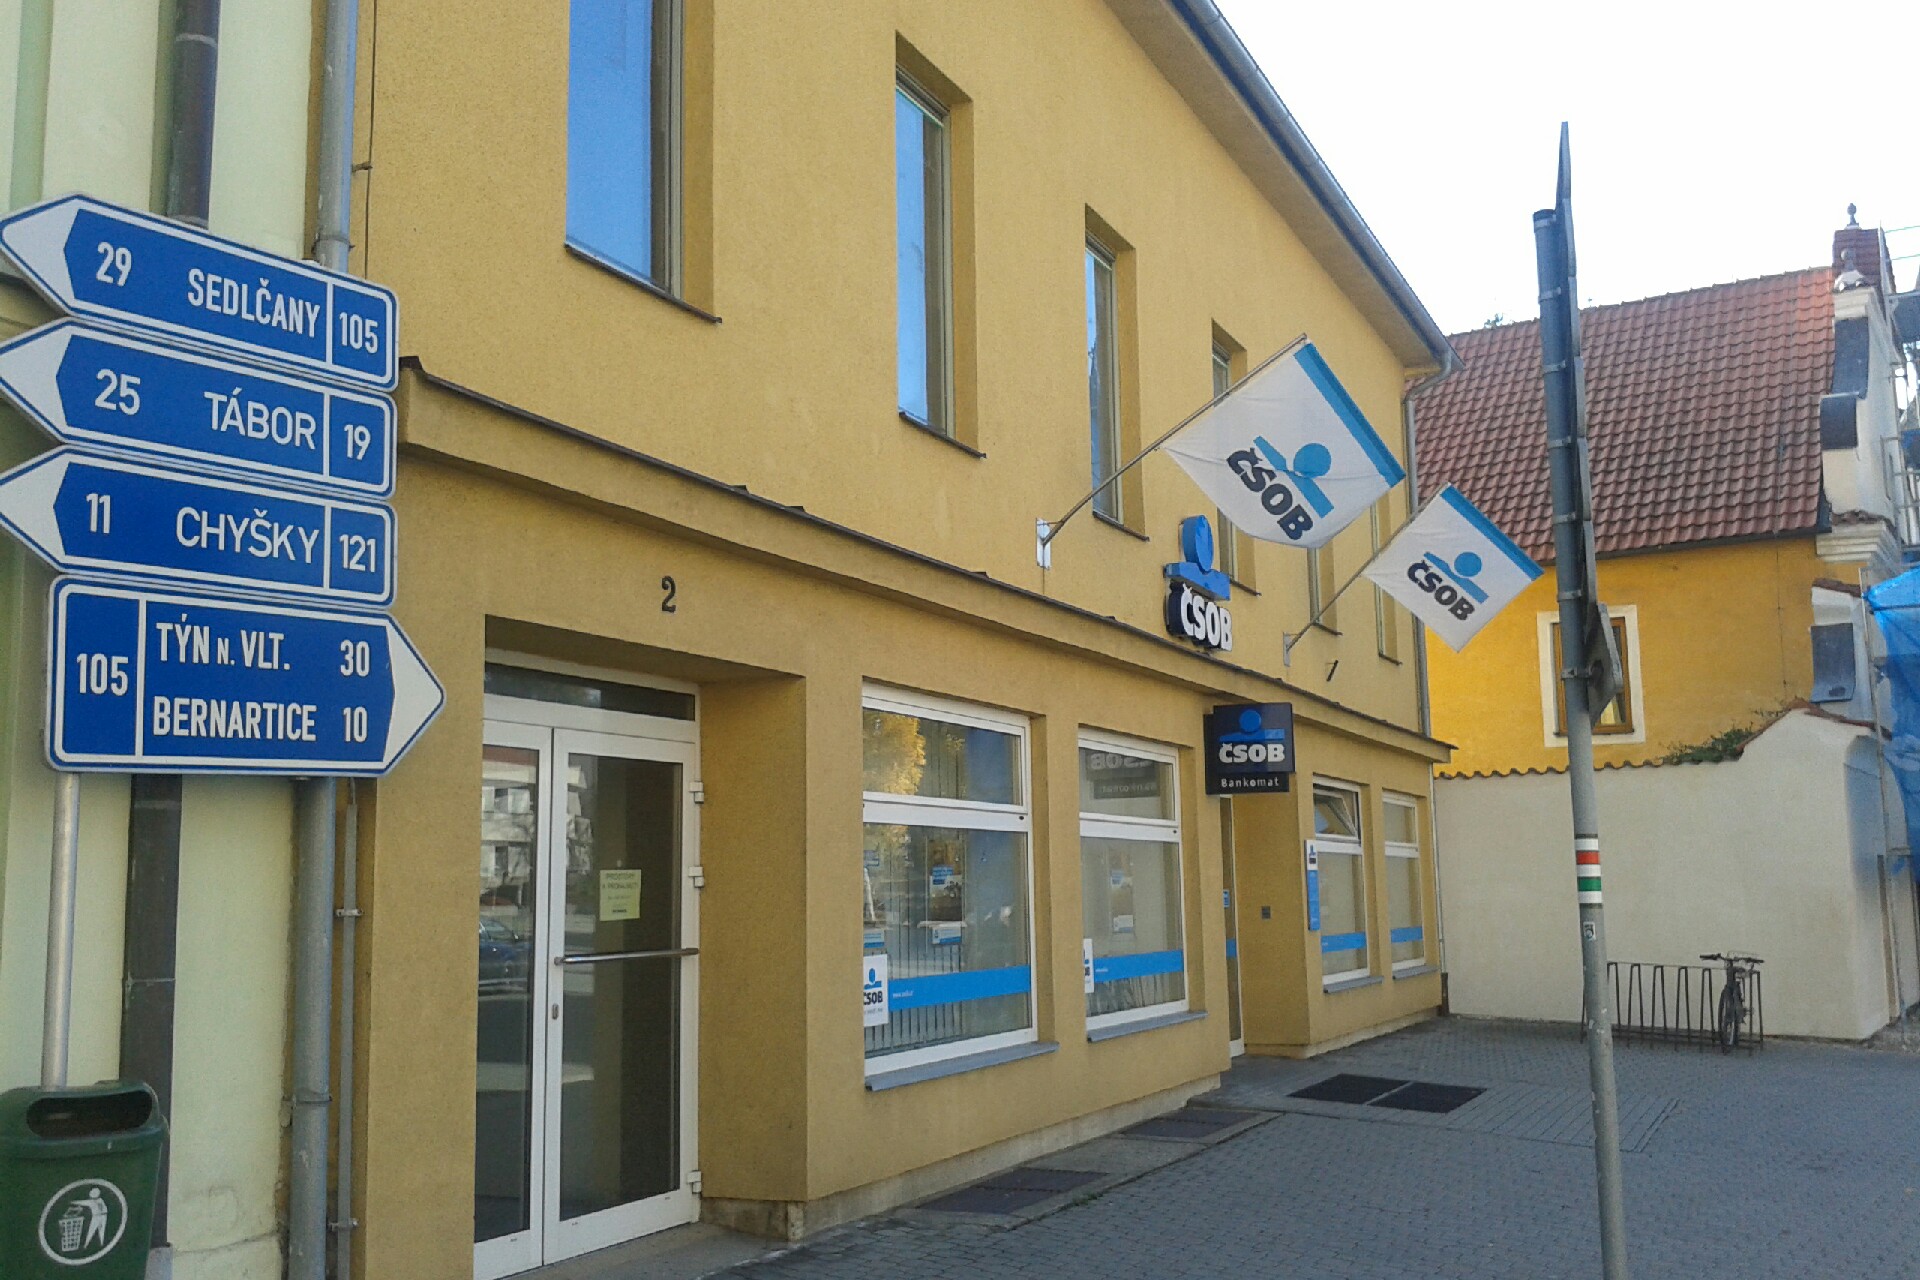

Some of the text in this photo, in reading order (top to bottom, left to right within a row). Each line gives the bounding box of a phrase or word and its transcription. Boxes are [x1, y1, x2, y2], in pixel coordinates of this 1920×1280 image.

[96, 242, 321, 338] 29 SEDLČANY
[340, 312, 378, 354] 105
[95, 369, 317, 450] 25 TÁBOR
[344, 425, 371, 460] 19
[1226, 447, 1313, 540] ČSOB
[87, 494, 320, 564] 11 CHYŠKY
[340, 535, 376, 573] 121
[662, 576, 676, 613] 2
[1407, 560, 1475, 621] ČSOB
[1181, 583, 1233, 651] ČSOB
[157, 613, 210, 664] TÝN
[241, 630, 291, 670] VLT.
[341, 640, 370, 677] 30
[77, 654, 129, 696] 105
[154, 696, 368, 743] BERNARTICE 10
[1219, 742, 1285, 764] ČSOB
[1221, 777, 1279, 787] Bankomat
